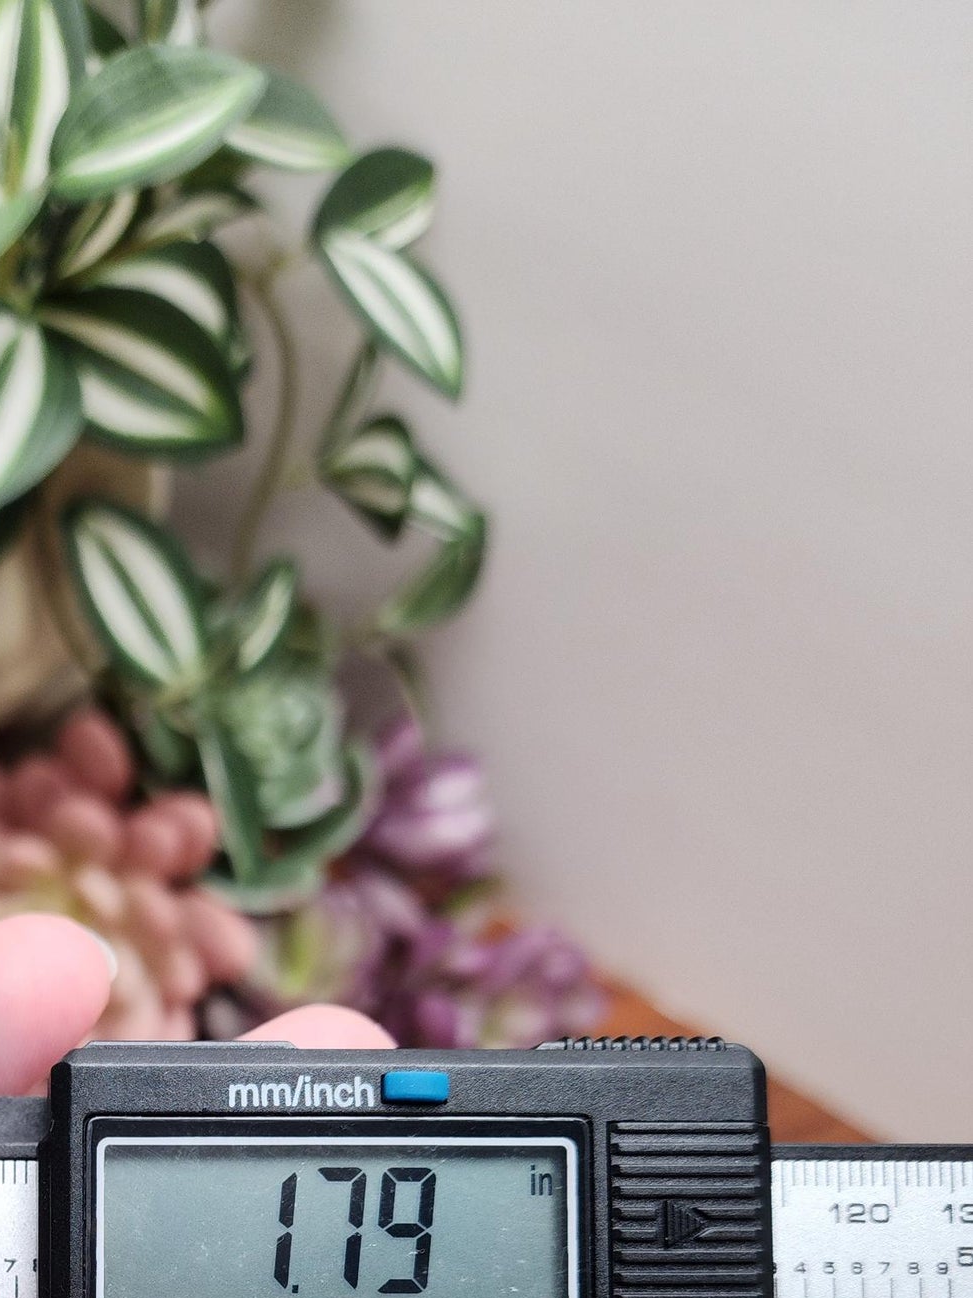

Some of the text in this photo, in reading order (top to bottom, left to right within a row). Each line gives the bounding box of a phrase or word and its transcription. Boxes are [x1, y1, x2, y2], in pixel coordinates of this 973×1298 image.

[228, 1075, 376, 1108] mm/inch
[830, 1202, 890, 1224] 120
[274, 1164, 553, 1294] 1.79 in
[3, 1258, 17, 1273] 7
